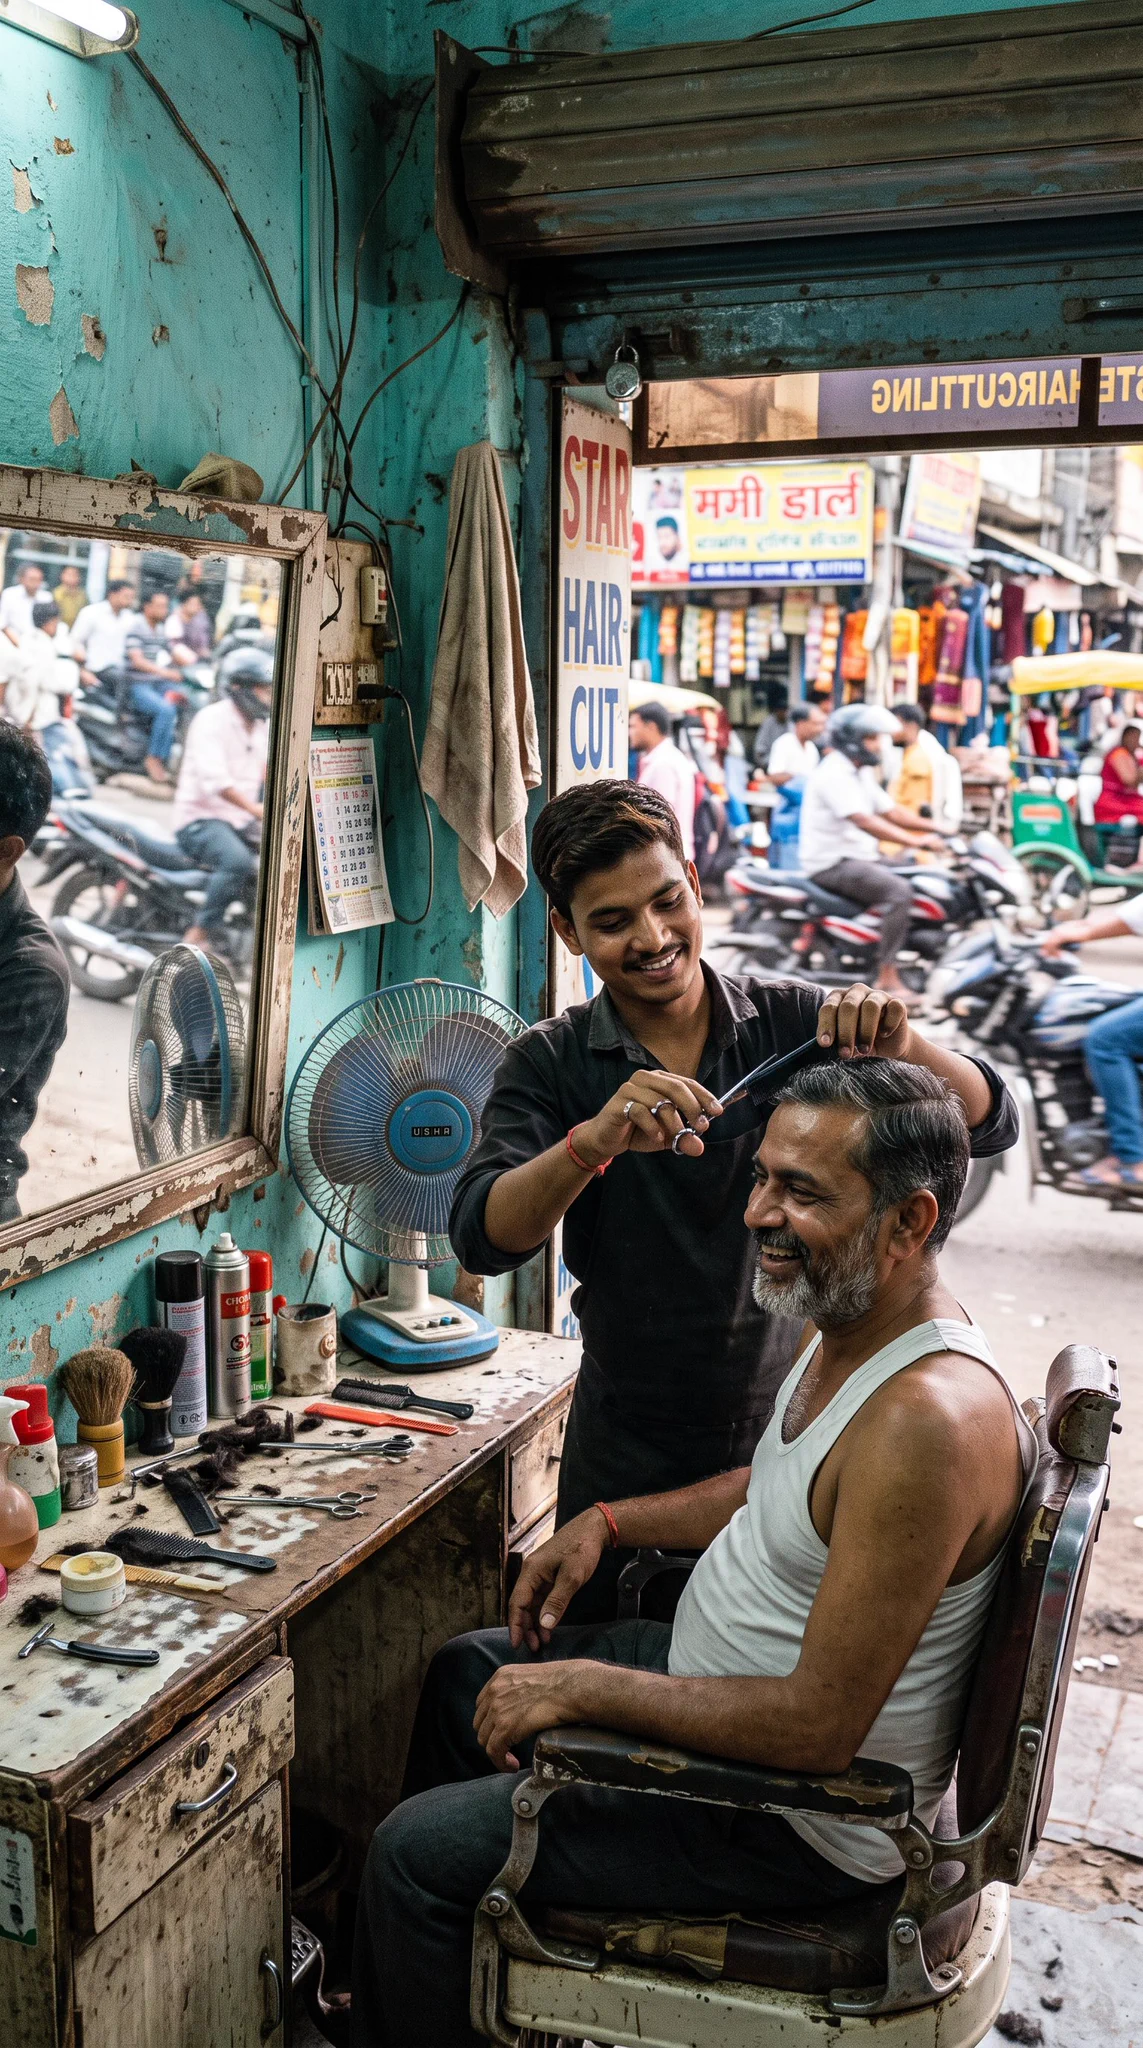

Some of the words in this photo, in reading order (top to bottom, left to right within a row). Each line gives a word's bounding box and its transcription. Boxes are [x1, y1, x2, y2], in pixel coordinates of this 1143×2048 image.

[563, 434, 629, 549] STAR
[563, 576, 623, 666] HAIR
[569, 684, 618, 771] CUT
[413, 1127, 450, 1136] USHA
